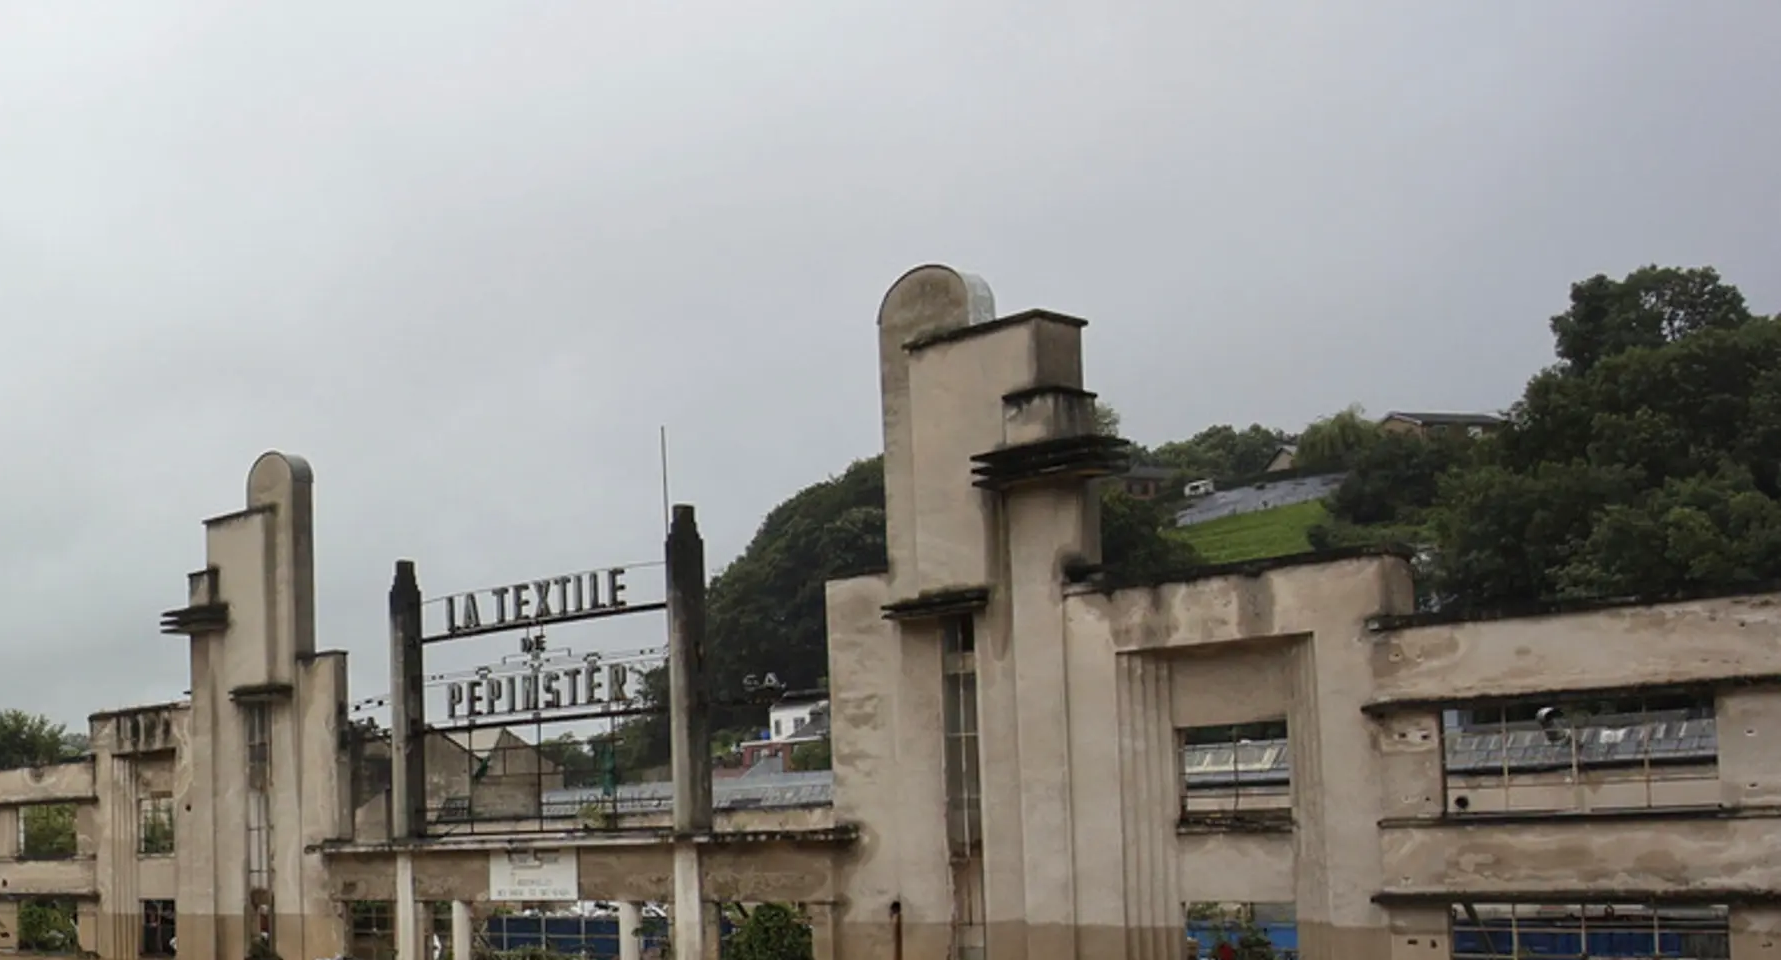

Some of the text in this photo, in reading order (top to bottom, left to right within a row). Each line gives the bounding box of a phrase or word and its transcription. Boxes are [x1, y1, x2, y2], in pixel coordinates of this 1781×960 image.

[445, 567, 627, 633] LA TEXTILE
[520, 634, 547, 653] DE
